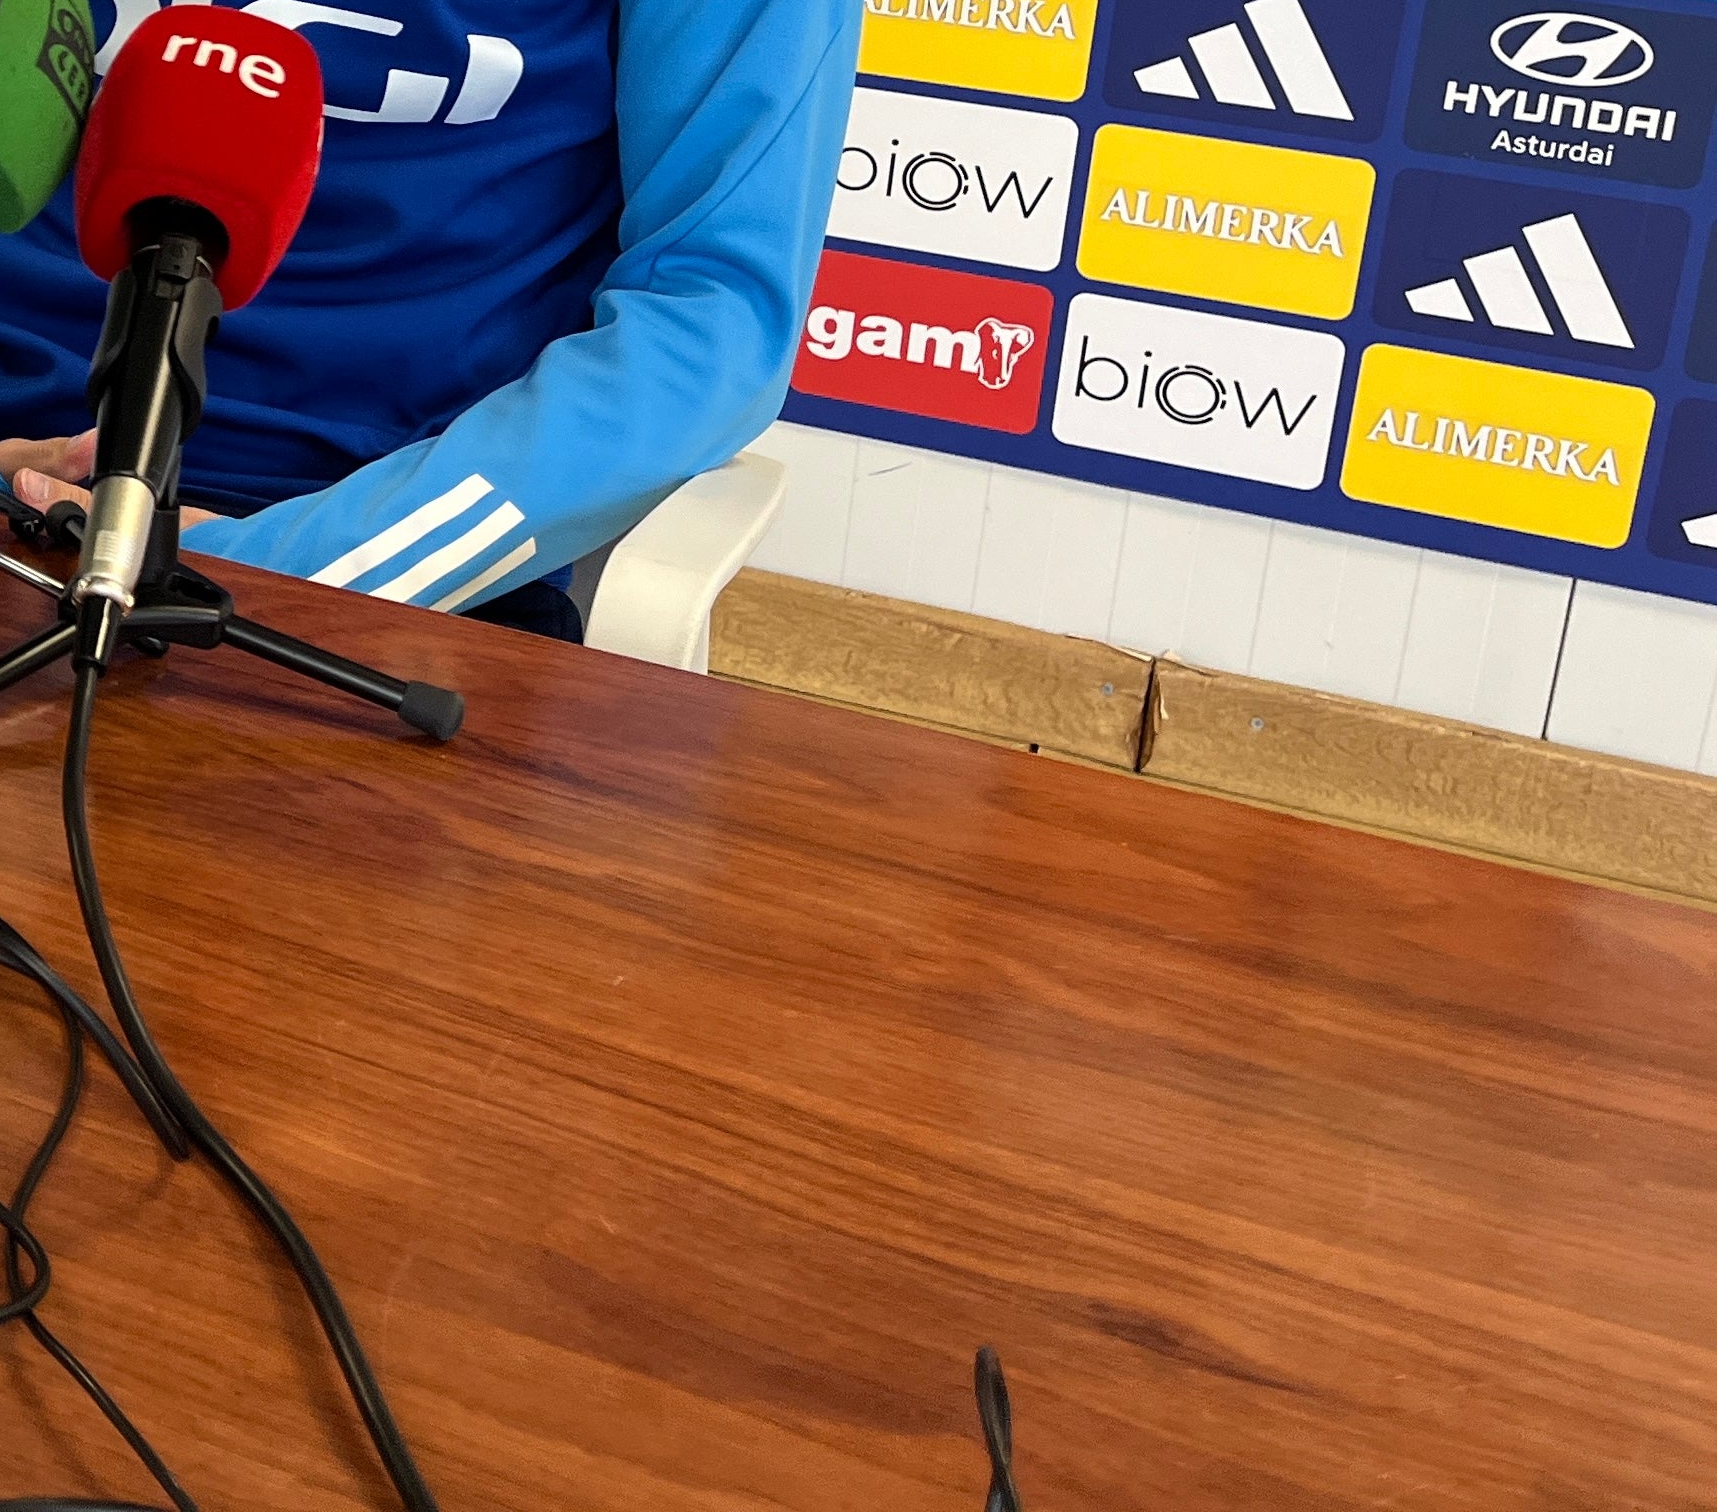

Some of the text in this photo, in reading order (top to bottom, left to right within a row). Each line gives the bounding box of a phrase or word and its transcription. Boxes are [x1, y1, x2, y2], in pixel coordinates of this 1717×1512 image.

[162, 34, 286, 99] rne
[1443, 80, 1677, 141] HYUNDAI
[1491, 129, 1614, 167] Asturdai
[1101, 187, 1344, 258] ALIMERKA
[1074, 336, 1317, 437] biow
[1365, 407, 1621, 487] ALIMERKA
